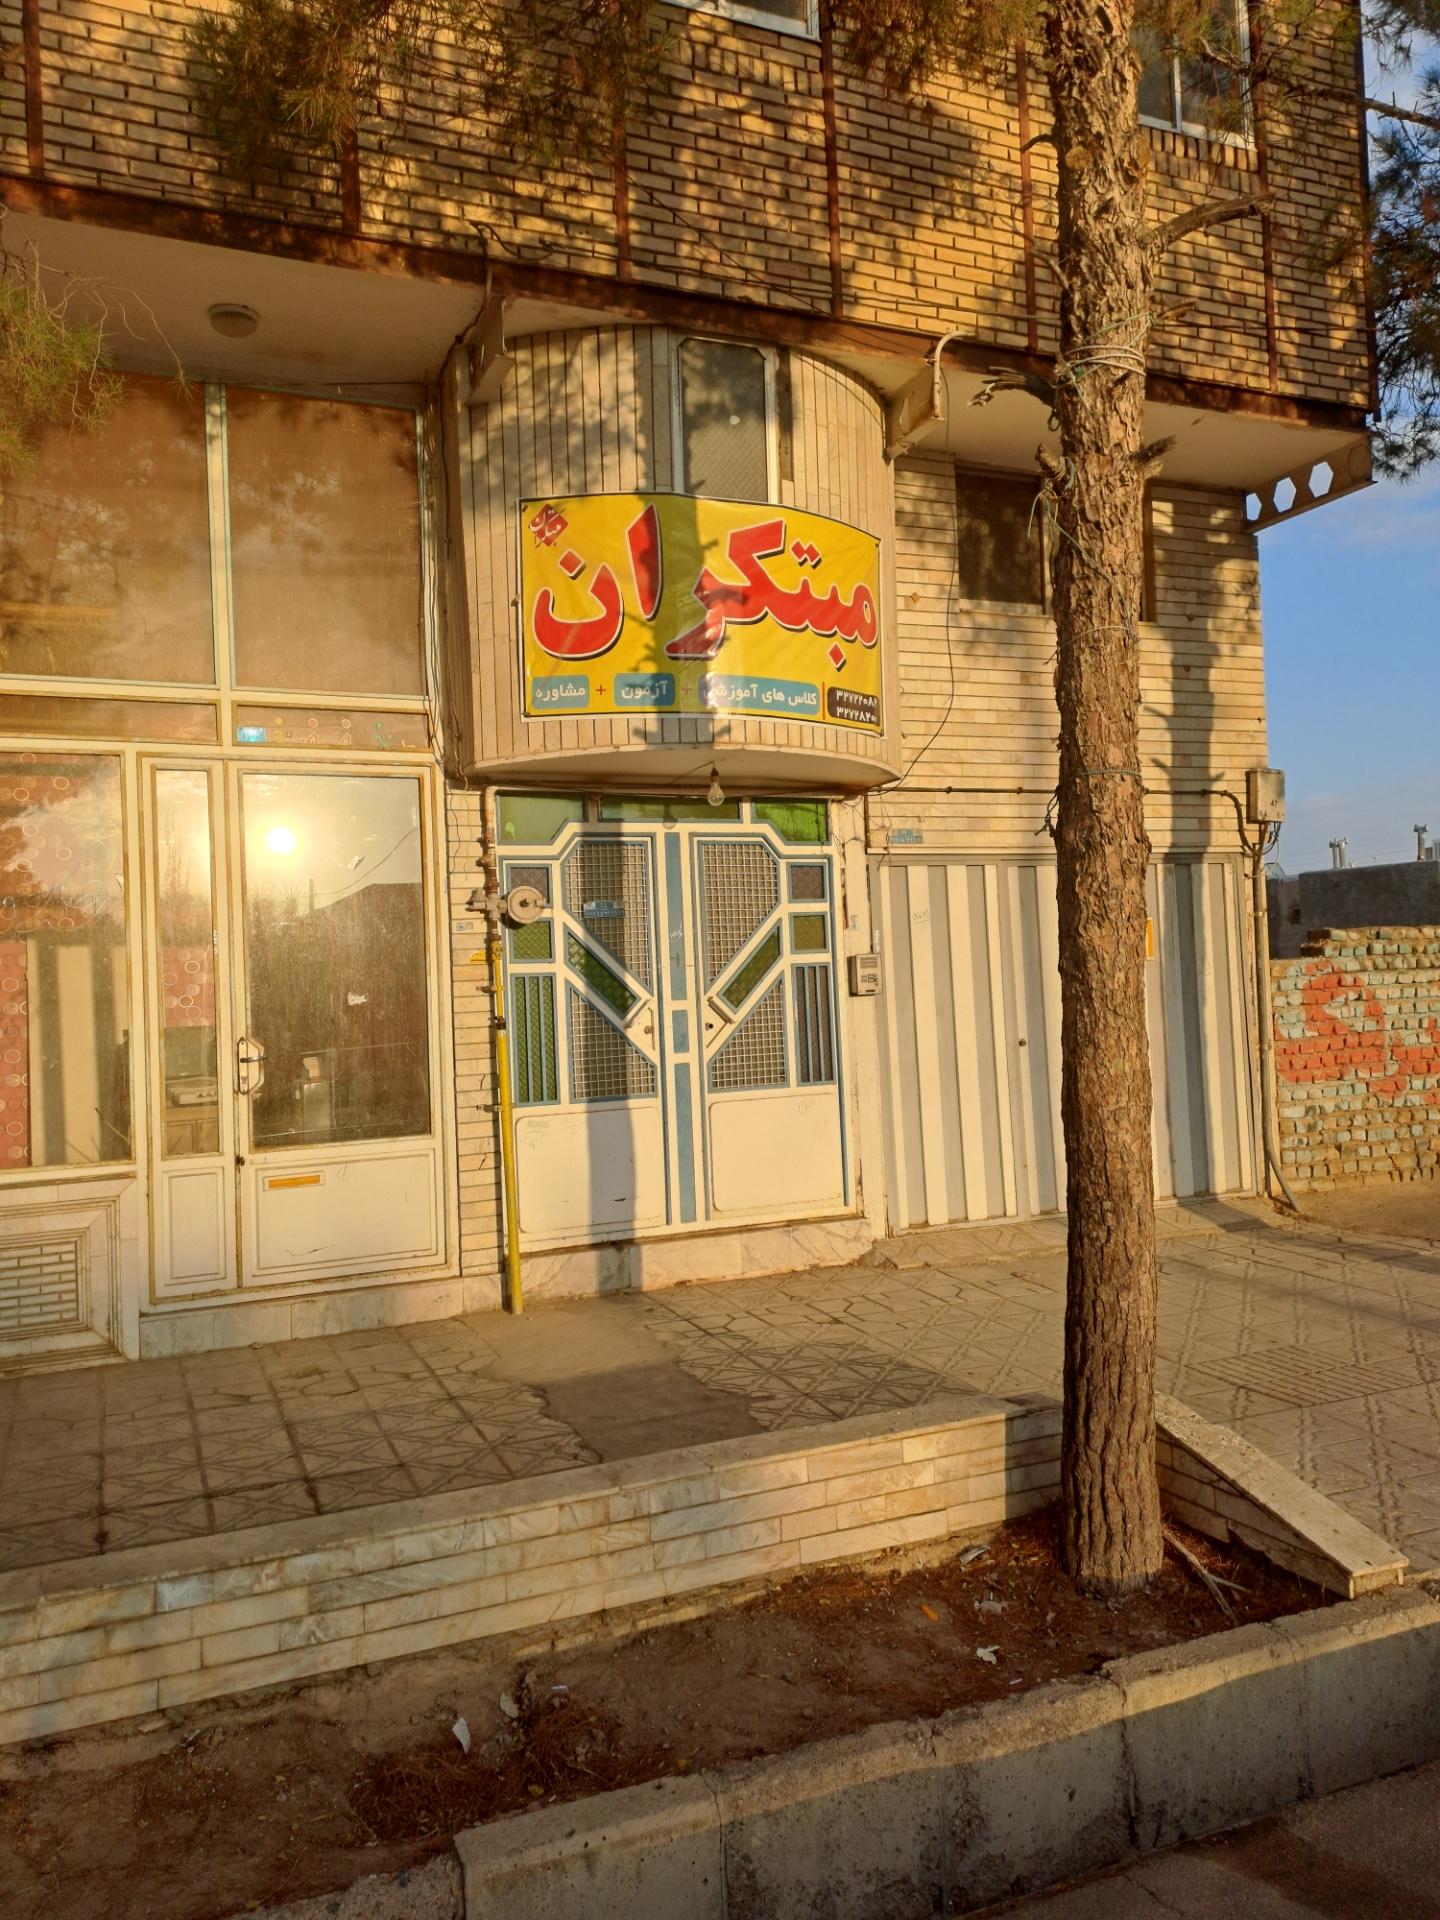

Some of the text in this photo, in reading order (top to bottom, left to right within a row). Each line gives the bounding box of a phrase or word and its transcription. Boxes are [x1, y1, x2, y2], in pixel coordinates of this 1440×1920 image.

[532, 501, 879, 671] مبتکران
[535, 682, 586, 702] مشاوره
[621, 680, 669, 699] آزمون
[707, 682, 758, 701] آموزش
[761, 687, 785, 703] های
[788, 691, 817, 706] کلاس
